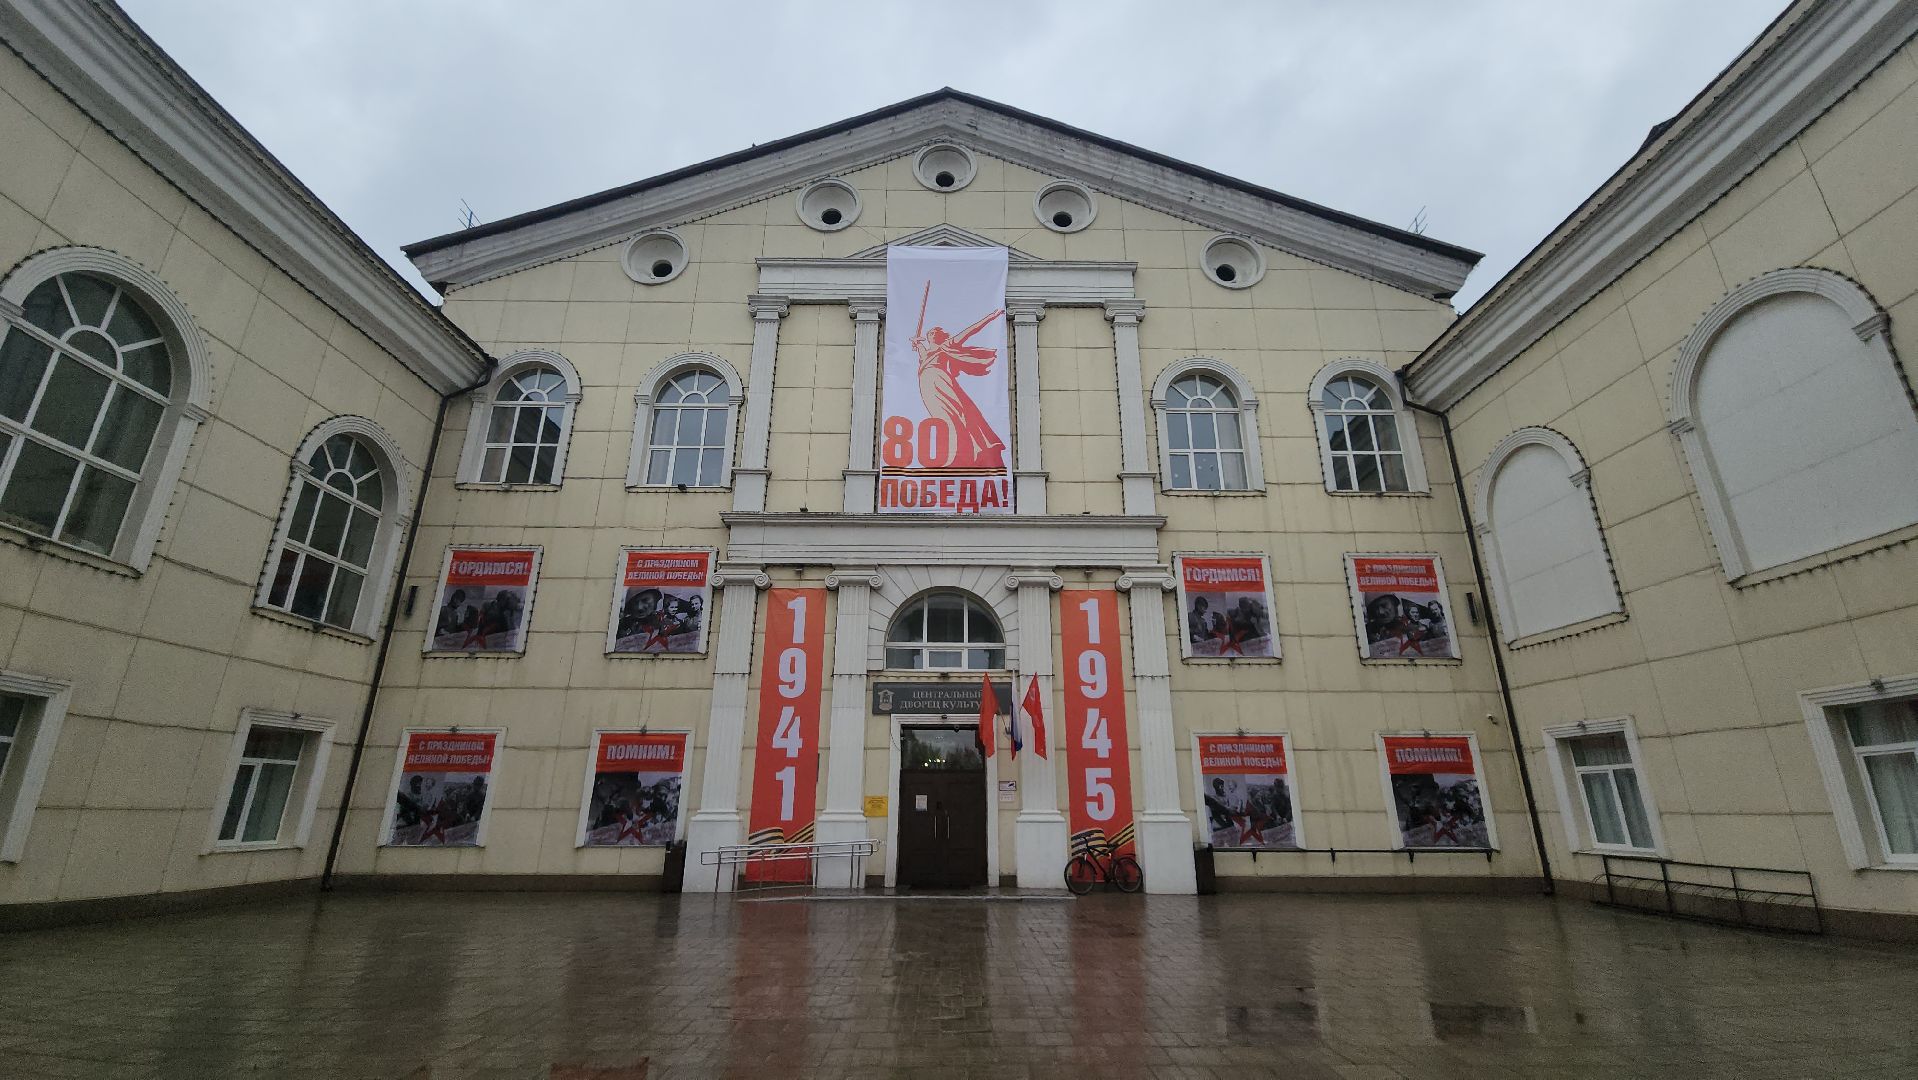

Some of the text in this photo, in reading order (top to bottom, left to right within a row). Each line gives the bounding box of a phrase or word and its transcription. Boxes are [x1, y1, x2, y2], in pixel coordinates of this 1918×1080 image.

[882, 415, 950, 468] 80
[880, 478, 1009, 514] ПОБЕДА!
[451, 560, 529, 577] ГОРДИМСЯ!
[644, 559, 699, 569] ПРАЗДНИКОМ
[628, 570, 704, 581] ВЕЛИКОЙ ПОБЕДЫ!
[1186, 566, 1261, 584] ГОРДИМСЯ!
[772, 596, 807, 821] 1941
[900, 700, 982, 710] ДВОРЕЦ КУЛЬТУ
[1078, 598, 1116, 821] 1945
[427, 741, 484, 751] ПРАЗДНИКОМ
[606, 744, 675, 760] ПОМНИМ!
[1209, 743, 1273, 753] С ПРАЗДНИКОМ
[449, 754, 489, 765] ПОБЕДЫ!
[1204, 756, 1283, 768] ВЕЛИКОЙ ПОБЕДЫ!
[1395, 747, 1463, 763] ПОМНИМ!
